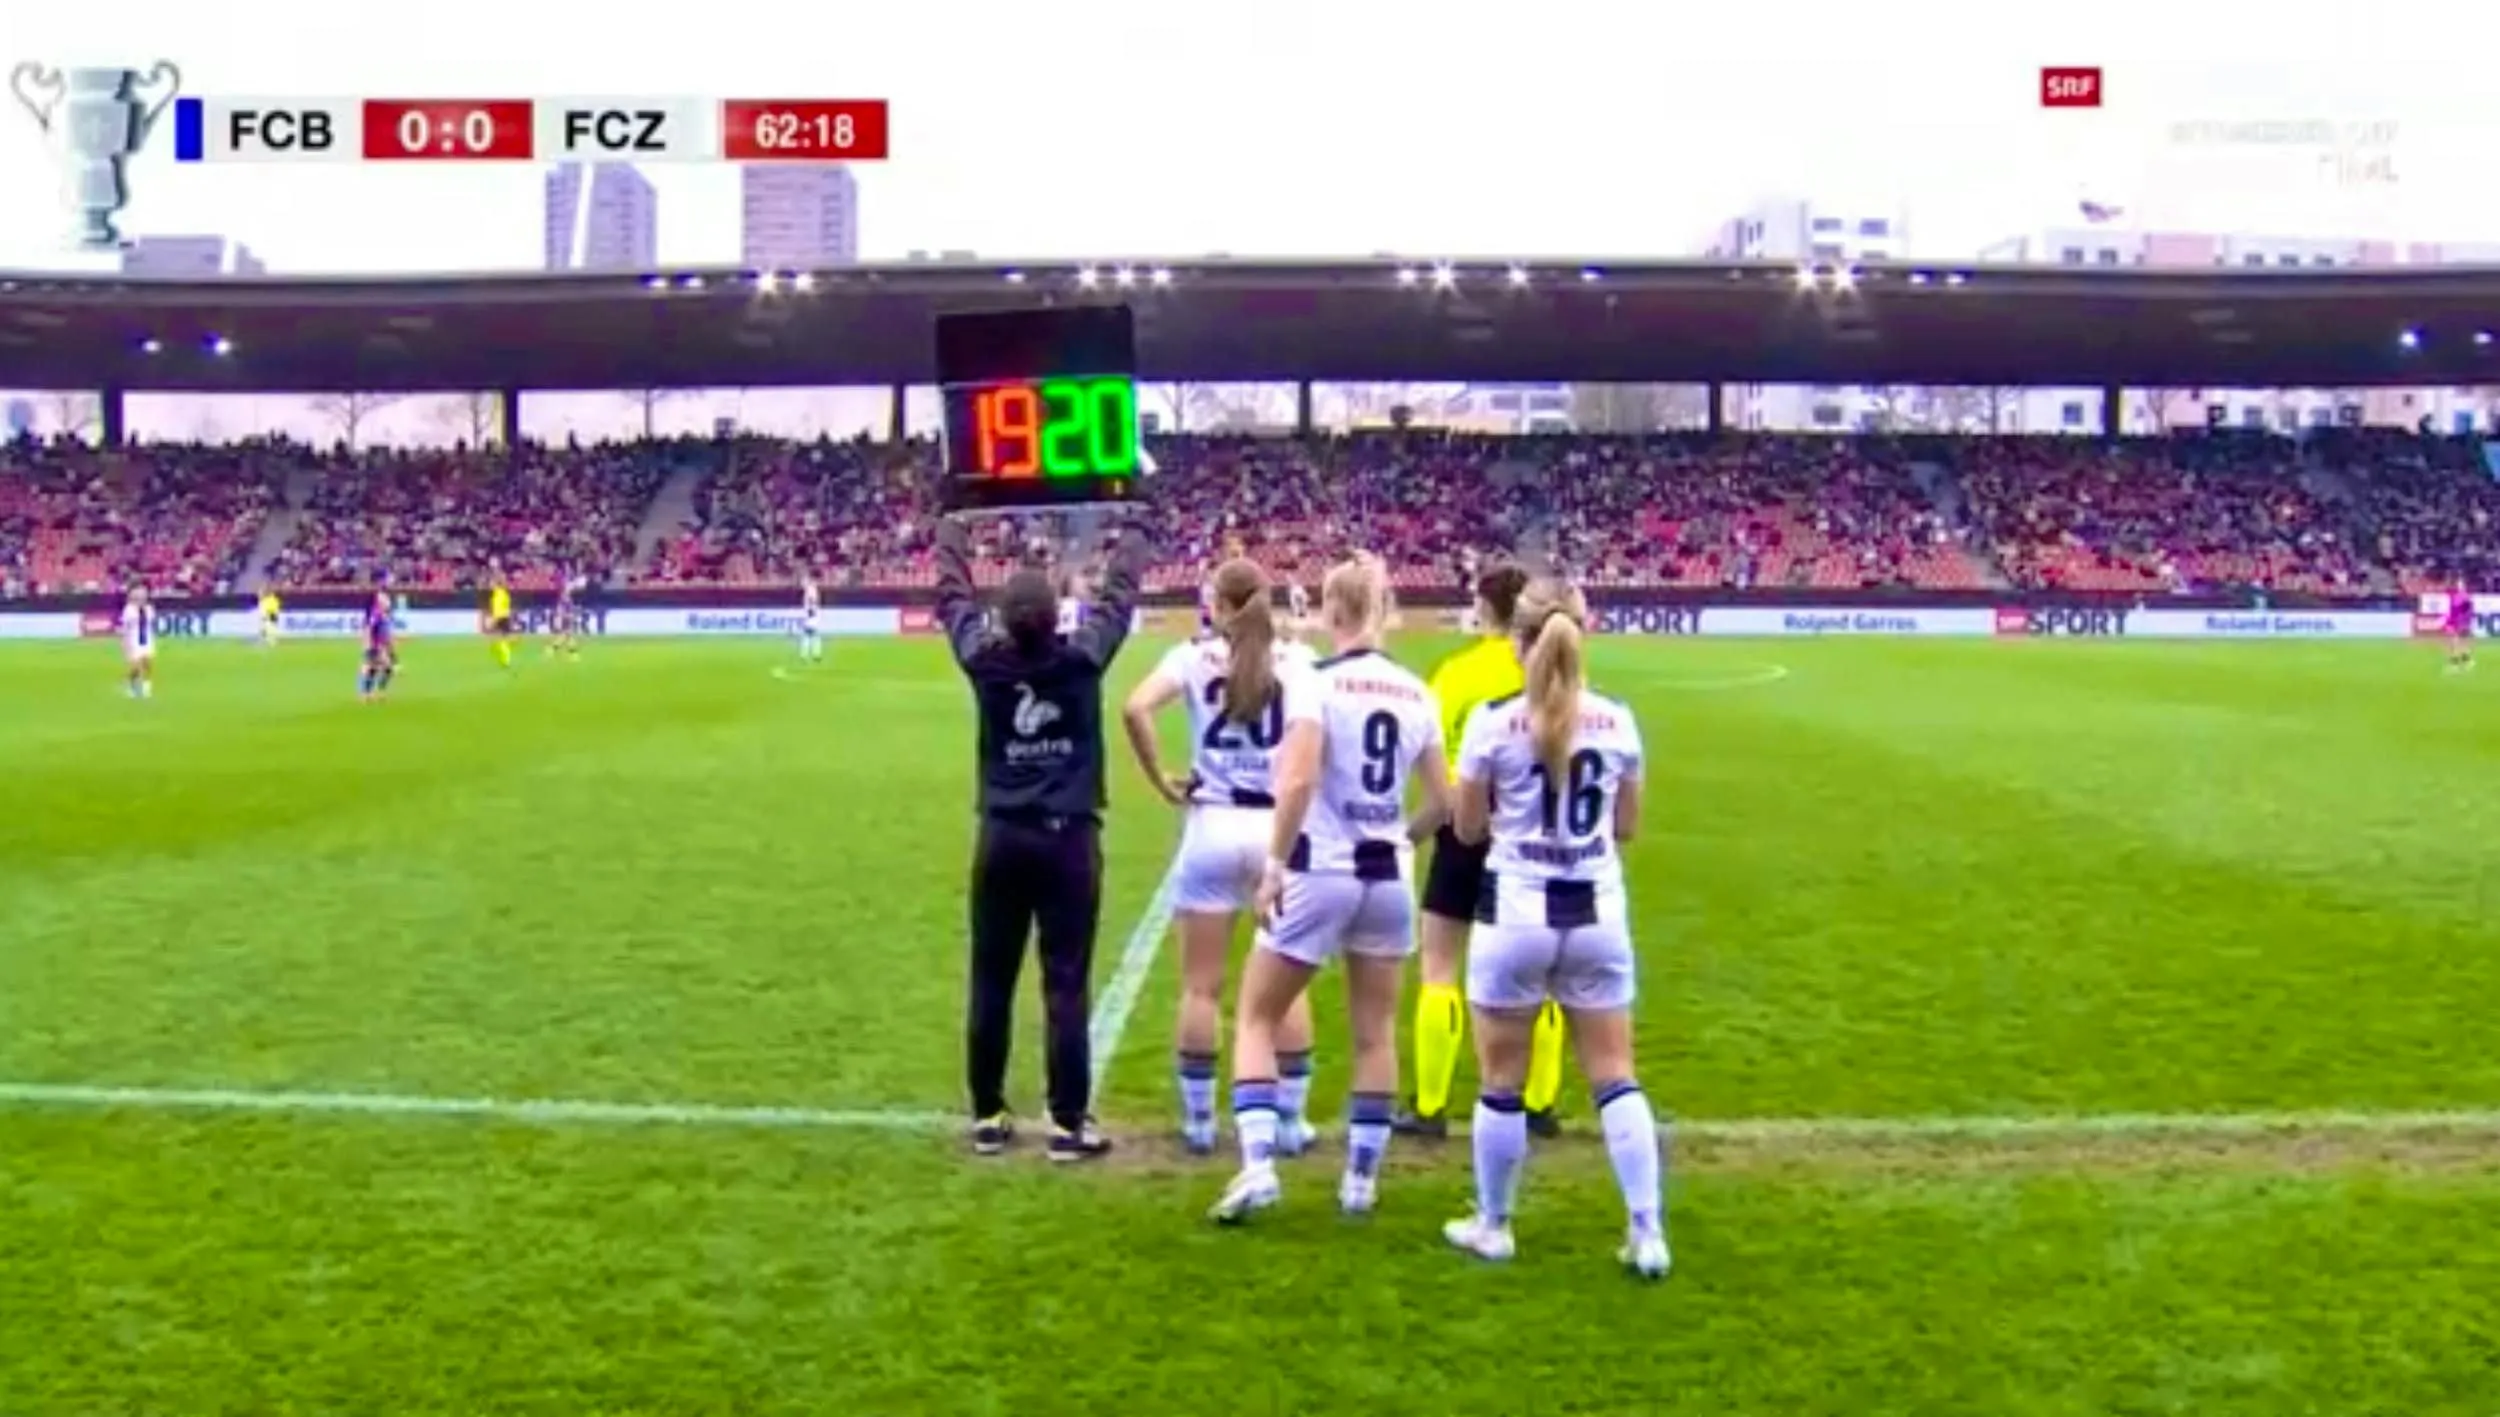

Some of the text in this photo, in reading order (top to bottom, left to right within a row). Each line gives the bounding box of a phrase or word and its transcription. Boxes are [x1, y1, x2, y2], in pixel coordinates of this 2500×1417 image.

[974, 378, 1136, 477] 19 20
[1600, 606, 1702, 634] SPORT
[2028, 608, 2128, 635] SPORT
[1203, 676, 1284, 749] 20
[1362, 709, 1399, 794] 9
[1529, 748, 1604, 837] 16
